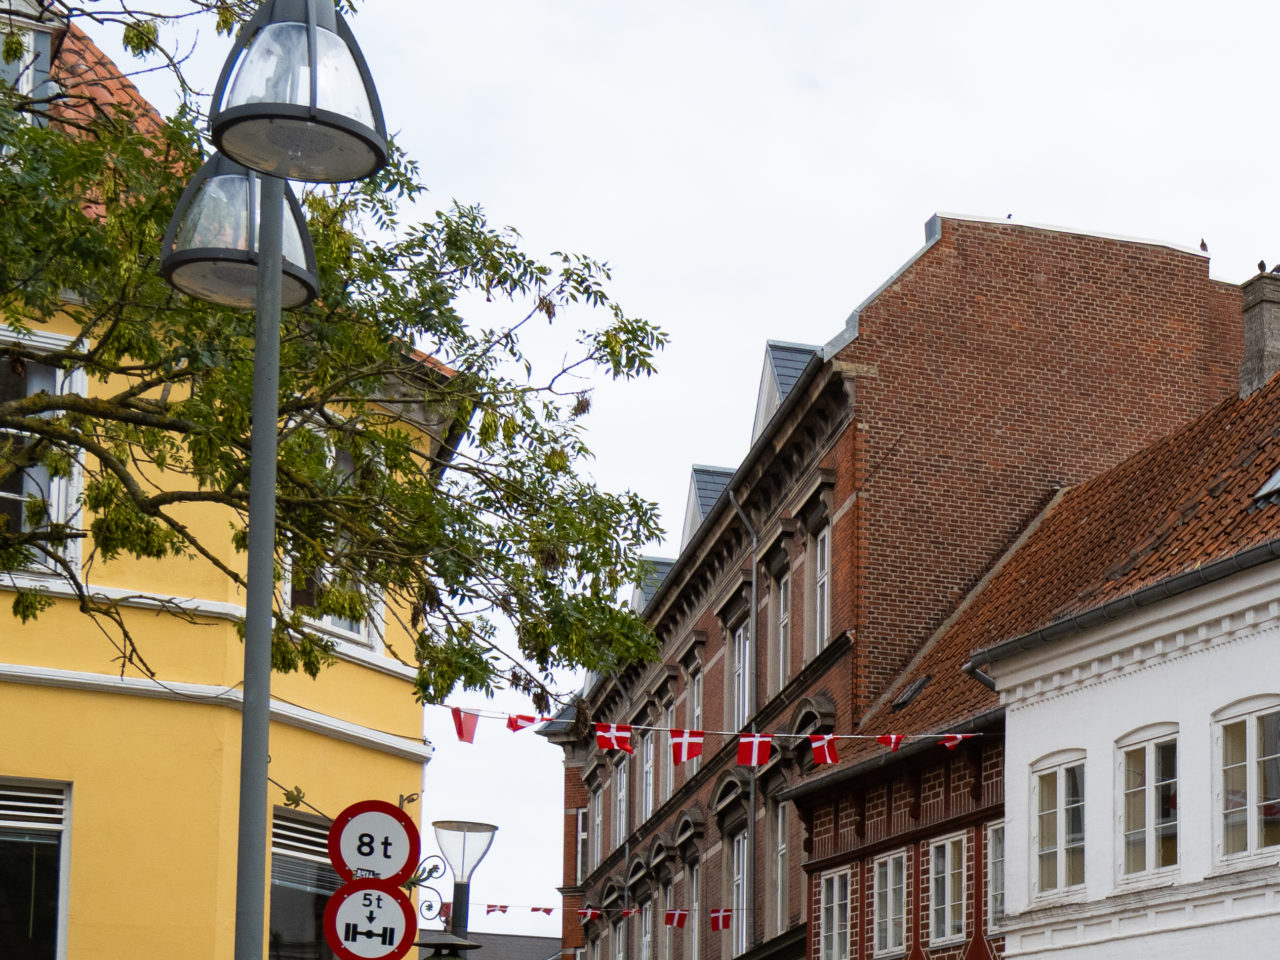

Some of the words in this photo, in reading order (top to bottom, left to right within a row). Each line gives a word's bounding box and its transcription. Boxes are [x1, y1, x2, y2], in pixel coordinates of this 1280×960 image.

[357, 833, 375, 857] 8
[381, 835, 393, 859] t
[362, 893, 373, 907] 5
[375, 895, 383, 909] t
